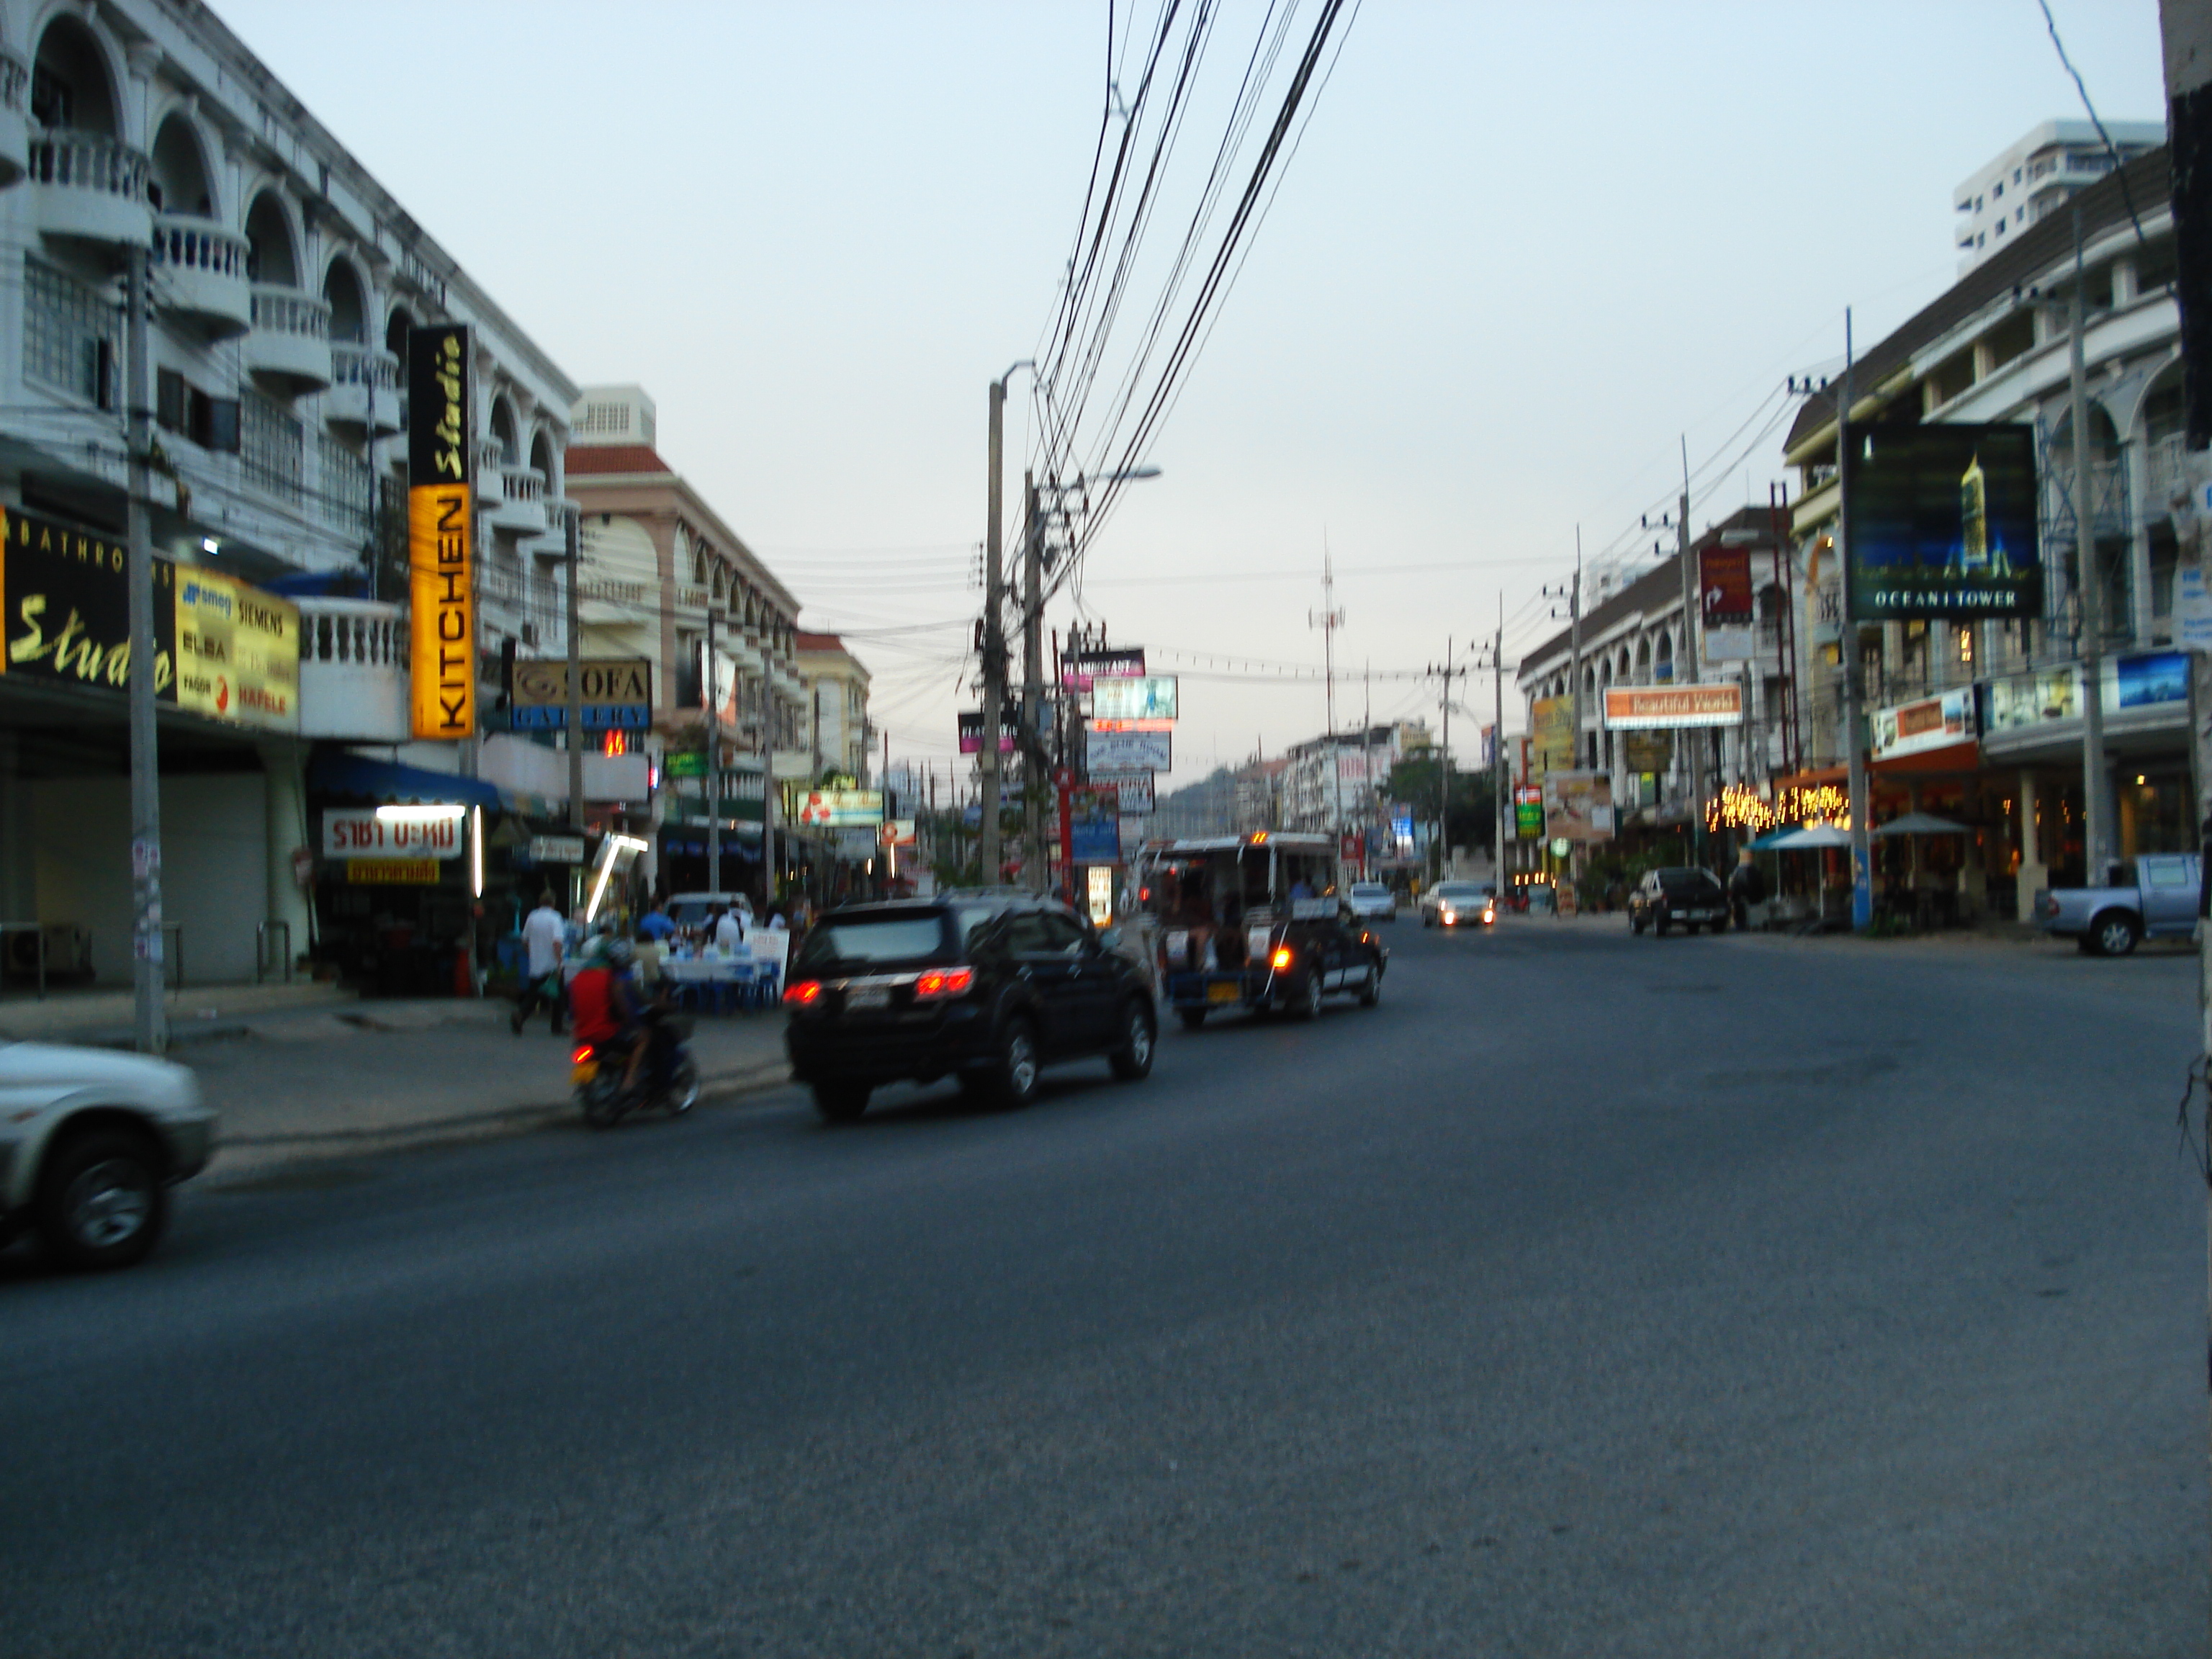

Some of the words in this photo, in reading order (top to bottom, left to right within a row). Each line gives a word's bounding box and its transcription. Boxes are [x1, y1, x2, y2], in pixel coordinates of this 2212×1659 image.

[435, 331, 462, 482] Studio
[238, 598, 284, 638] SIEMENS
[436, 495, 467, 730] KITCHEN
[1874, 590, 1938, 608] OCEAN
[1956, 590, 2015, 608] TOWER
[9, 593, 176, 694] Studo
[514, 704, 644, 724] GALERY
[1634, 693, 1689, 715] Beautiful
[1694, 690, 1733, 711] World
